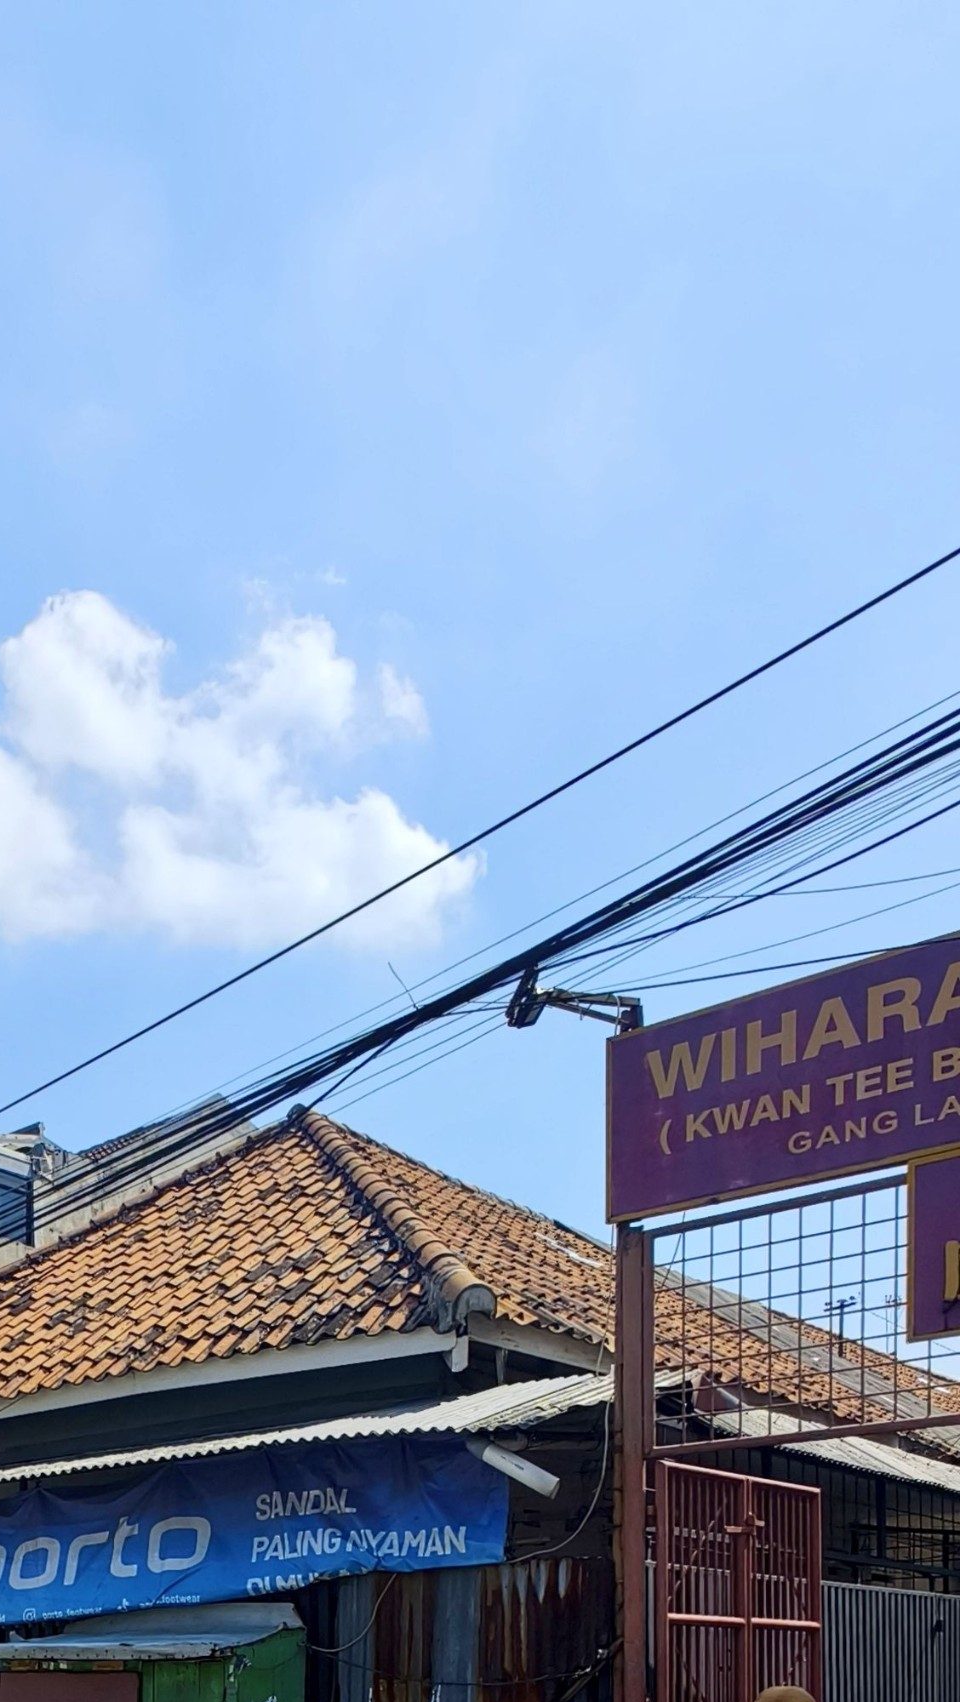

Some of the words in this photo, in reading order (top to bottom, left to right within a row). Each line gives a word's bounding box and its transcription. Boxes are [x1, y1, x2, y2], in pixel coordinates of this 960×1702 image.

[685, 1083, 810, 1143] KWAN
[826, 1057, 915, 1107] TEE
[788, 1110, 899, 1154] GANG
[256, 1487, 357, 1521] SANDAL
[251, 1528, 341, 1563] PALING
[346, 1525, 467, 1558] NYAMAN
